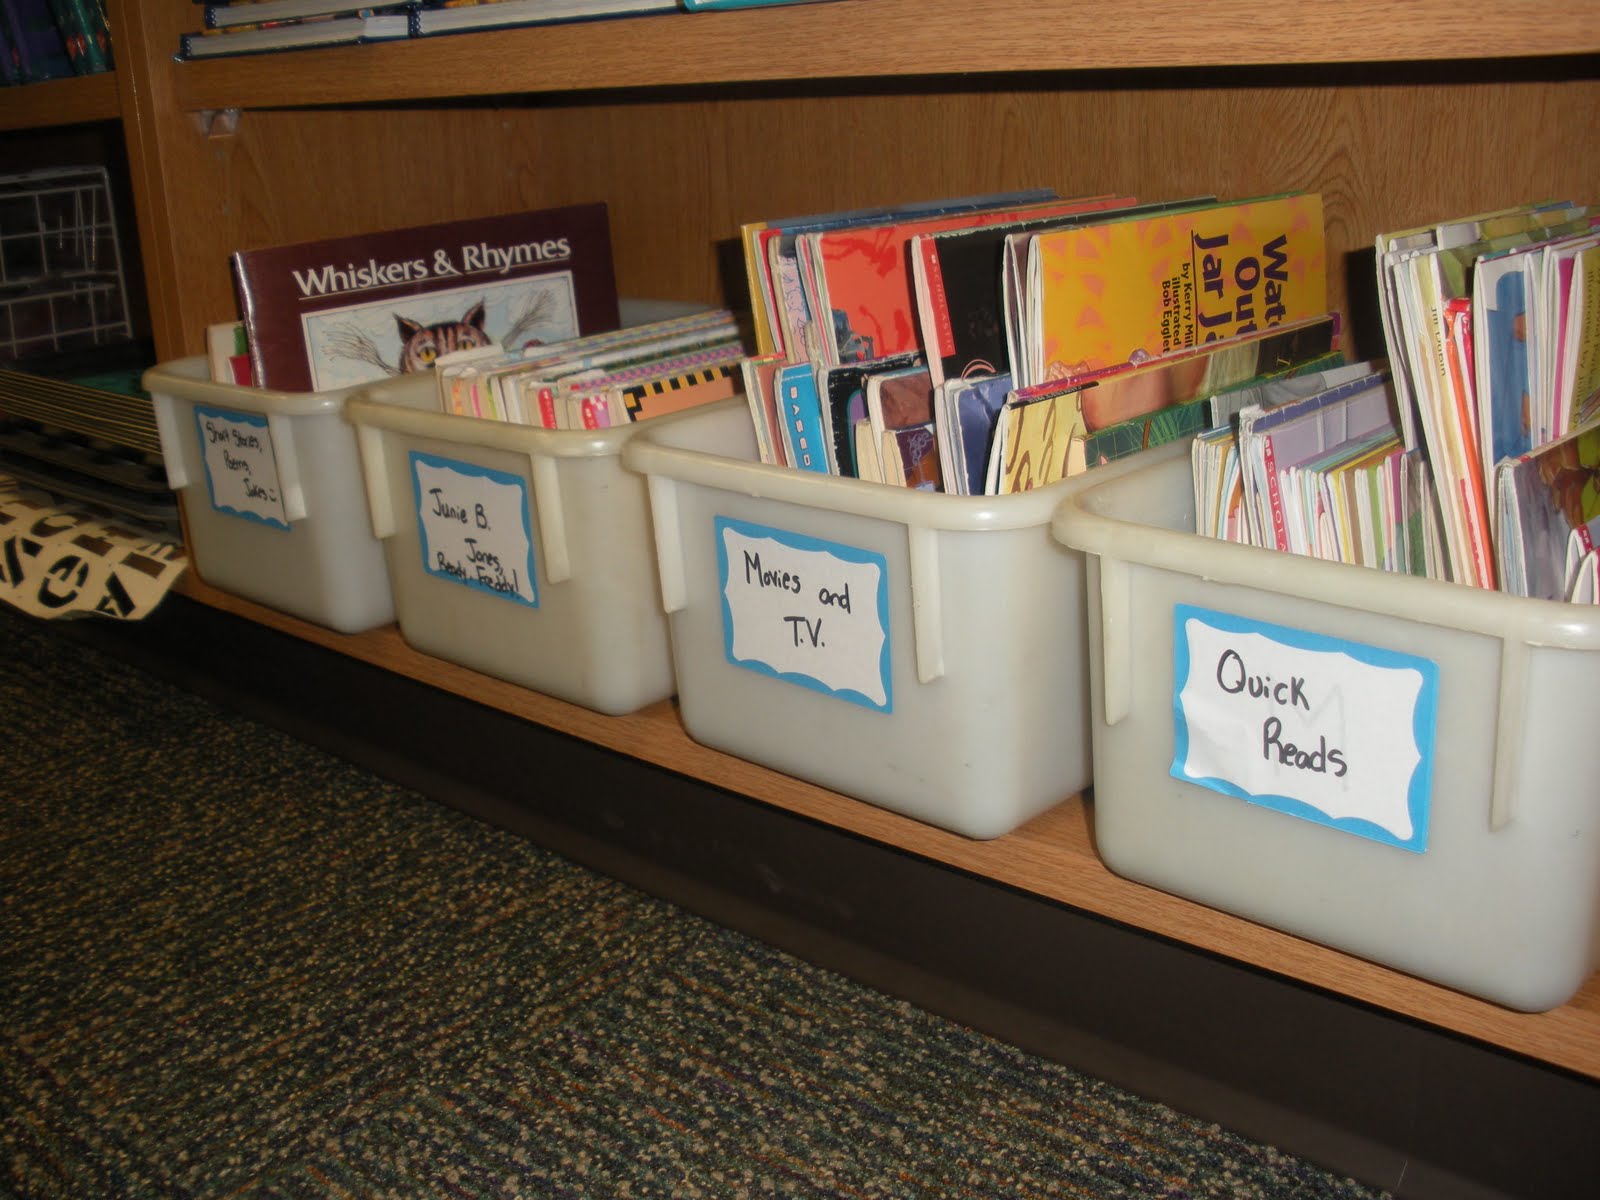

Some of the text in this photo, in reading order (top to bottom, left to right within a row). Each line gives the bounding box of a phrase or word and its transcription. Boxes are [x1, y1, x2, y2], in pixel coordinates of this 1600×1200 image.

[292, 237, 571, 296] Whiskers & Rhymes
[1162, 280, 1171, 307] Bob
[1181, 263, 1190, 279] by
[1194, 233, 1229, 299] Jar
[1234, 256, 1261, 335] Out
[933, 265, 952, 352] SCHOLASTIC
[1172, 277, 1181, 346] illustrated
[1183, 282, 1194, 321] Kerry
[429, 488, 491, 531] Junie B.
[464, 537, 504, 576] Jones,
[743, 550, 851, 615] Movies and
[783, 616, 826, 648] T.V.
[1216, 649, 1310, 711] Quick
[1263, 716, 1348, 777] Reads
